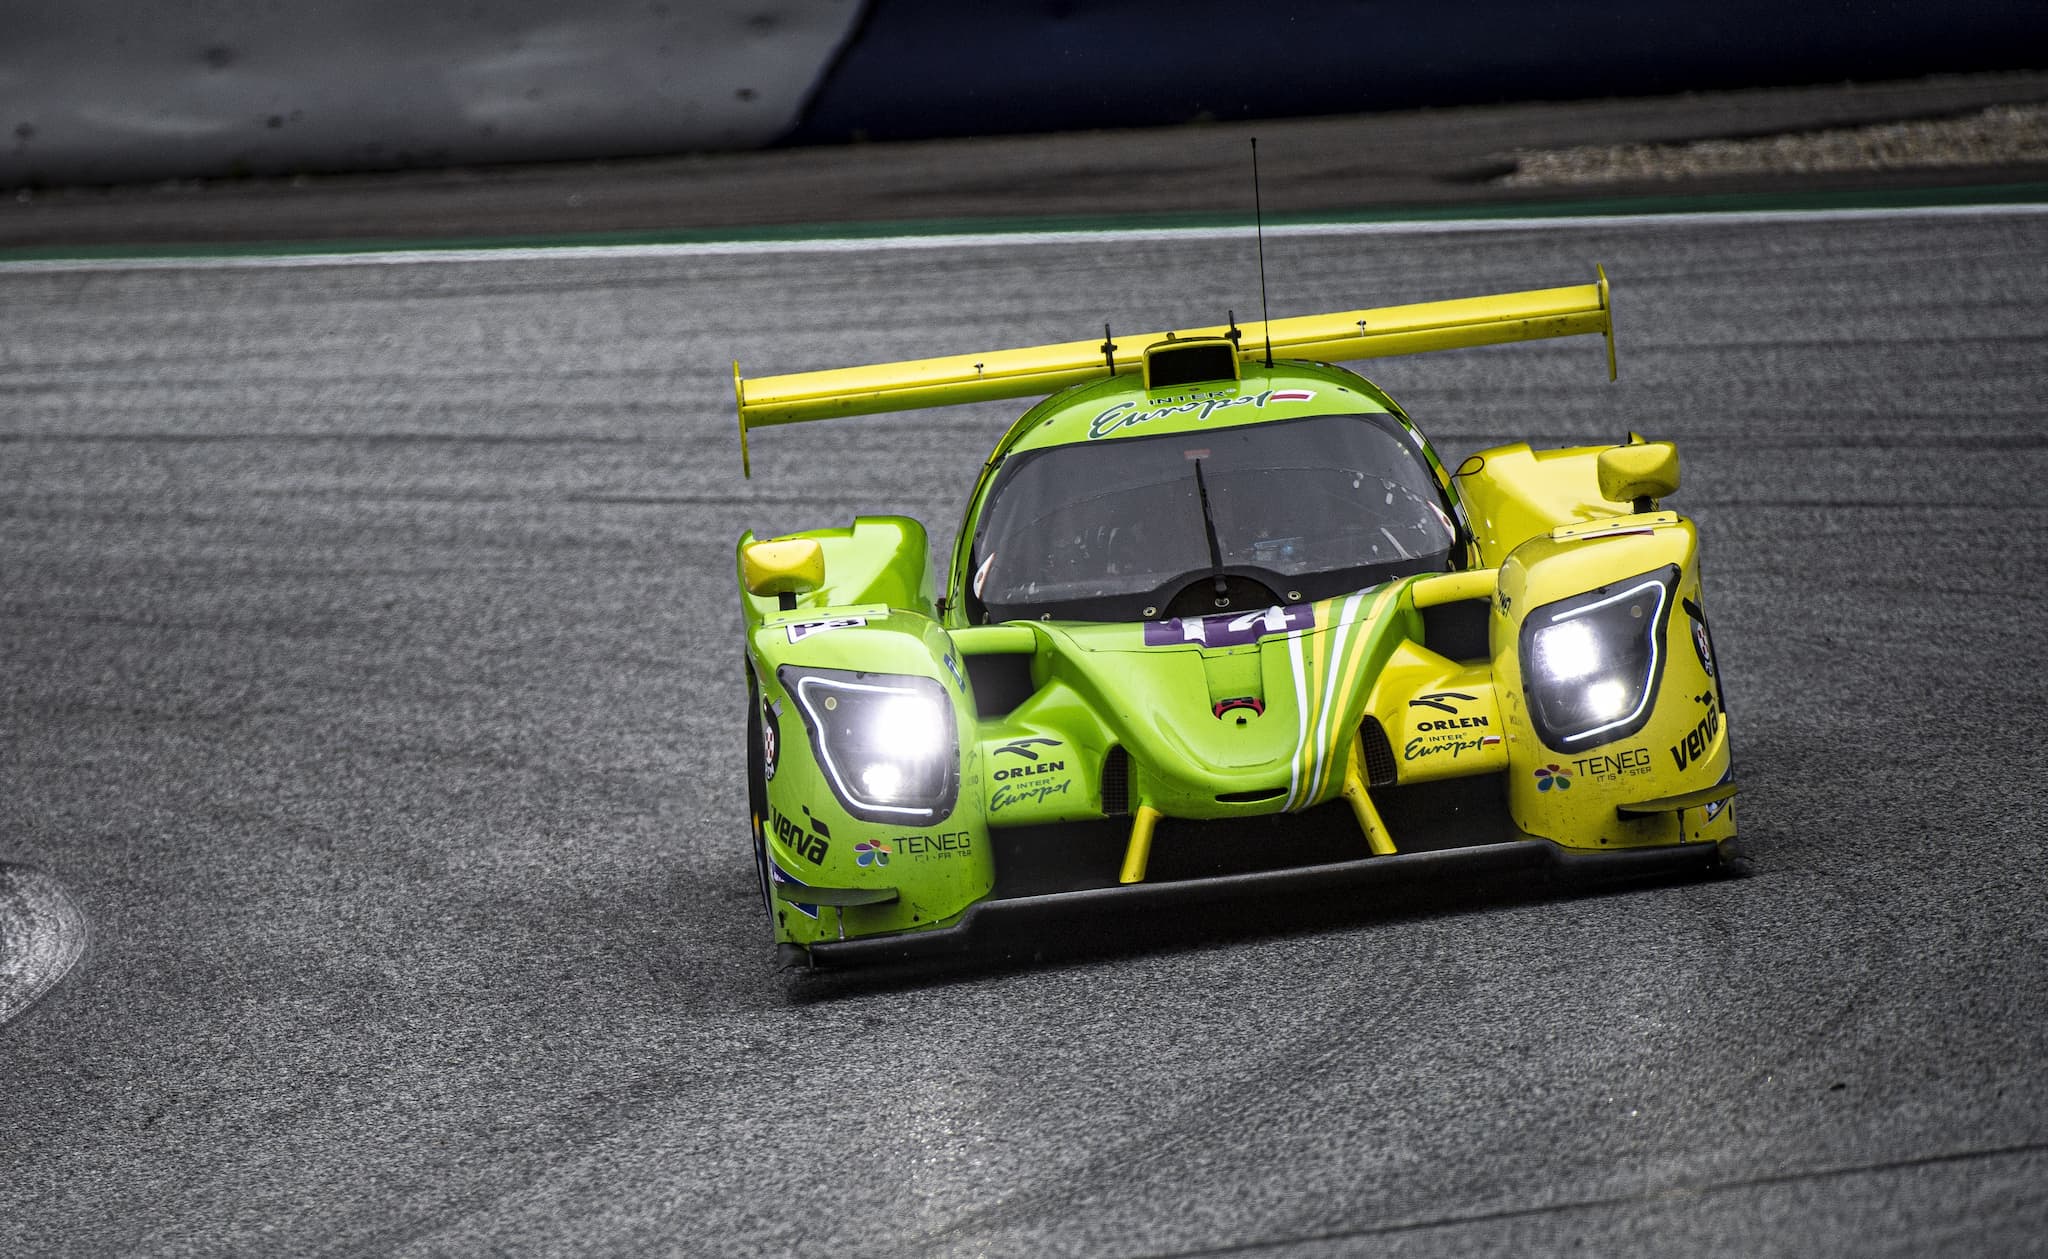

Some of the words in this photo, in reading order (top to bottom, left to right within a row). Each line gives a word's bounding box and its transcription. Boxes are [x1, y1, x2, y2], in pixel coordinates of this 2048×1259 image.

[1149, 390, 1225, 406] INTER
[1088, 390, 1273, 439] Europol
[1417, 716, 1489, 732] ORLEN
[1404, 736, 1484, 761] Europol
[1429, 733, 1463, 742] INTER
[1670, 703, 1719, 772] verva
[993, 760, 1065, 781] ORLEN
[1572, 748, 1650, 777] TENEG
[990, 779, 1071, 812] Europol
[1016, 778, 1050, 790] INTER
[771, 804, 830, 866] verva
[892, 831, 971, 855] TENEG
